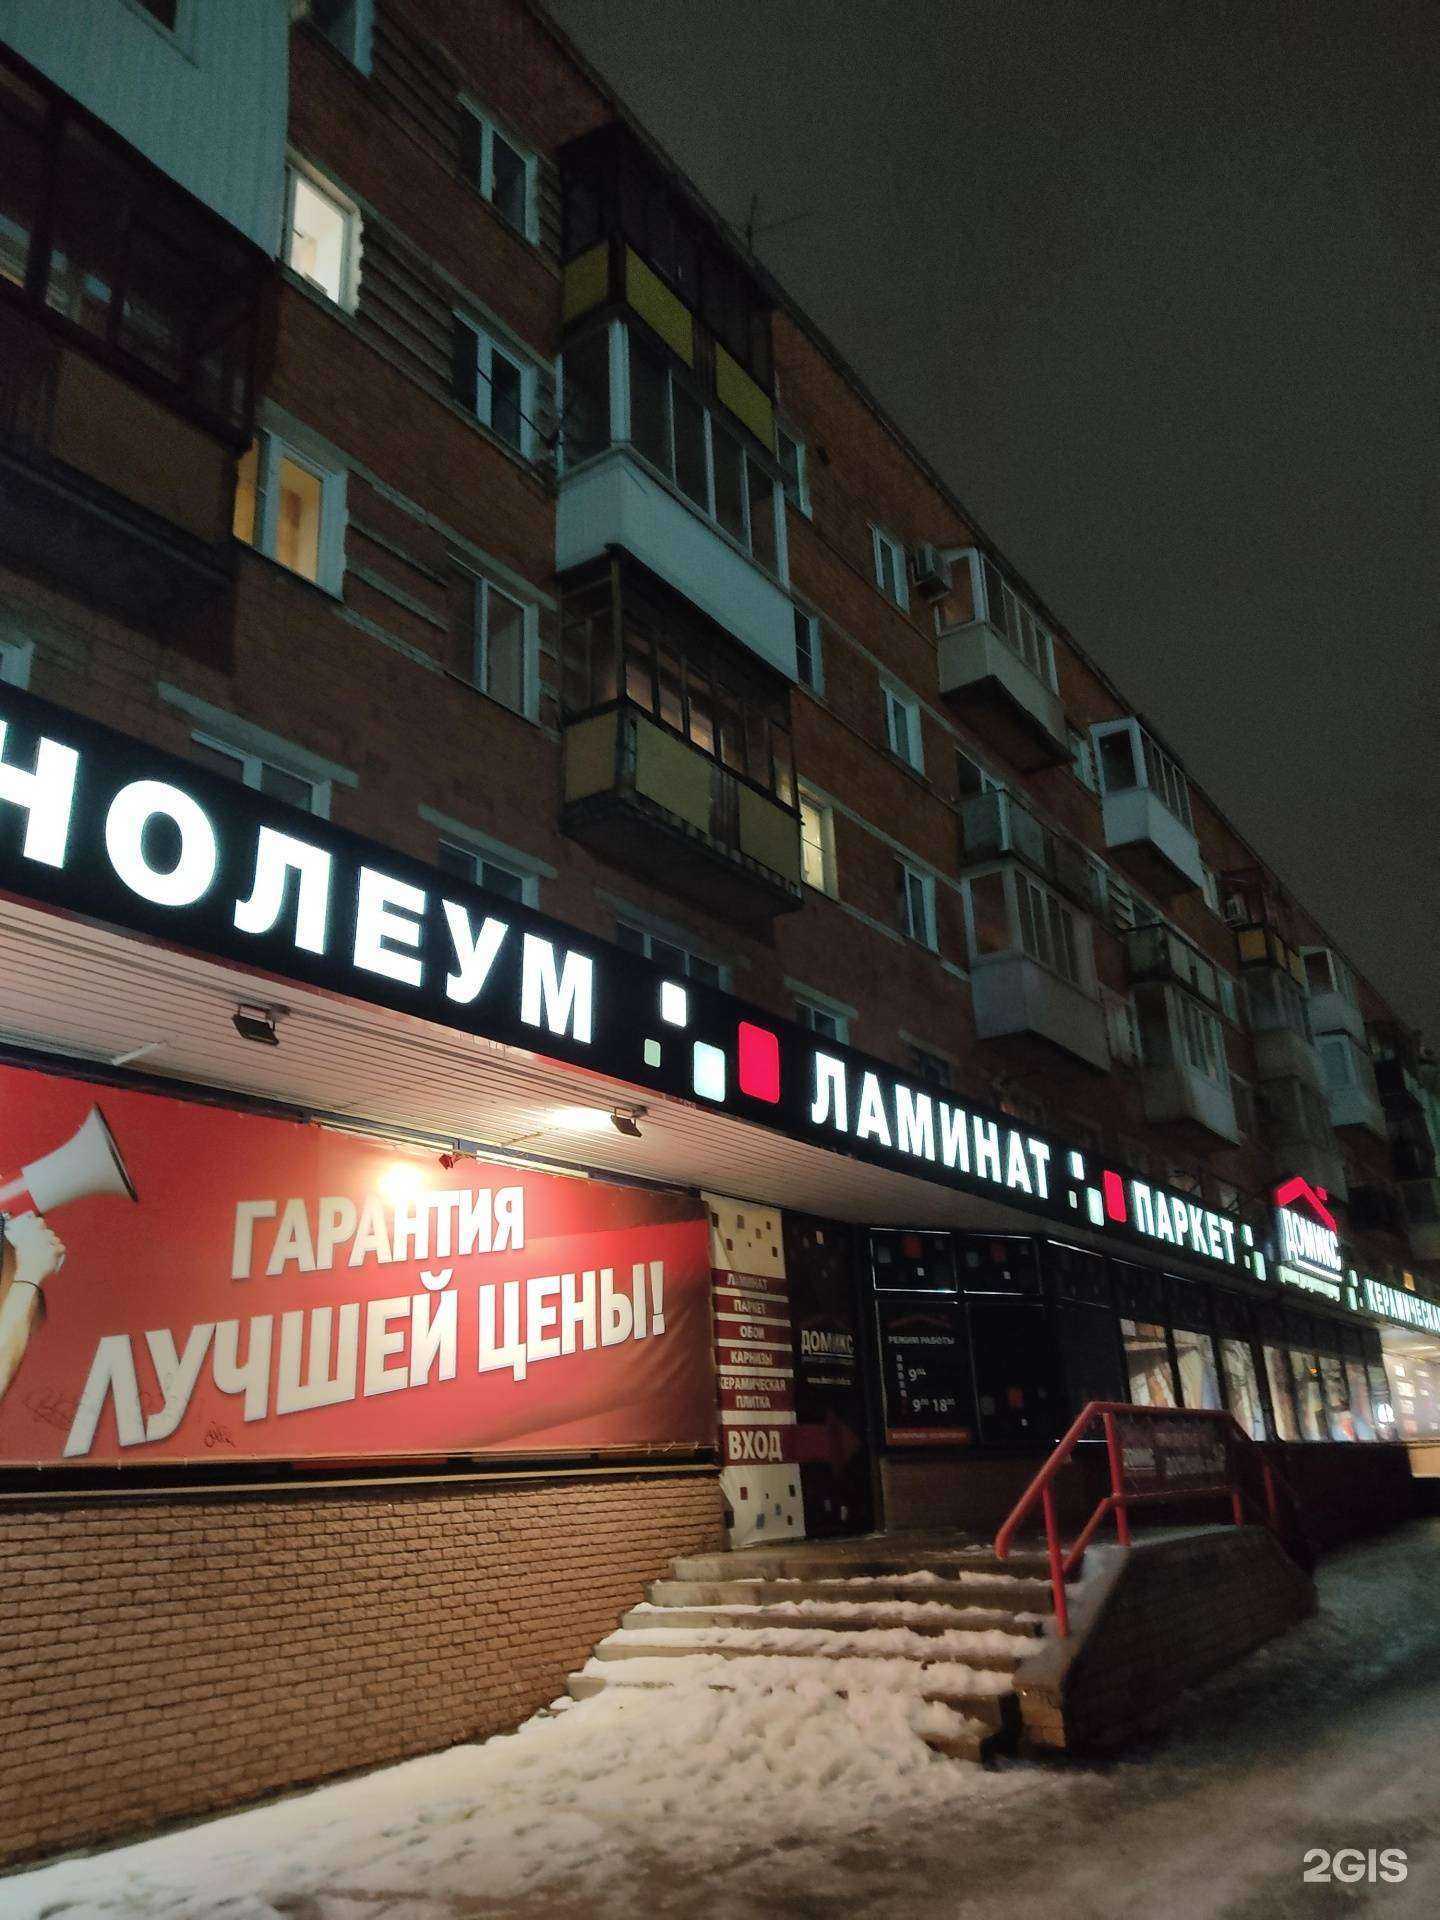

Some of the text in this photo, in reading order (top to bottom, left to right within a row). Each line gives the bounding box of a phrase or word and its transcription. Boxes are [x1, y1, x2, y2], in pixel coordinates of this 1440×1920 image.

[811, 1051, 1050, 1199] ЛАМИНАТ
[231, 1186, 525, 1279] ГАРАНТИЯ
[1131, 1180, 1235, 1264] ПАРКЕТ
[1281, 1207, 1342, 1271] ДОМИКС
[63, 1261, 666, 1458] ЛУЧШЕЙ ЦЕНЫ!
[739, 1325, 765, 1339] ОБОИ
[728, 1430, 783, 1462] ВХОД
